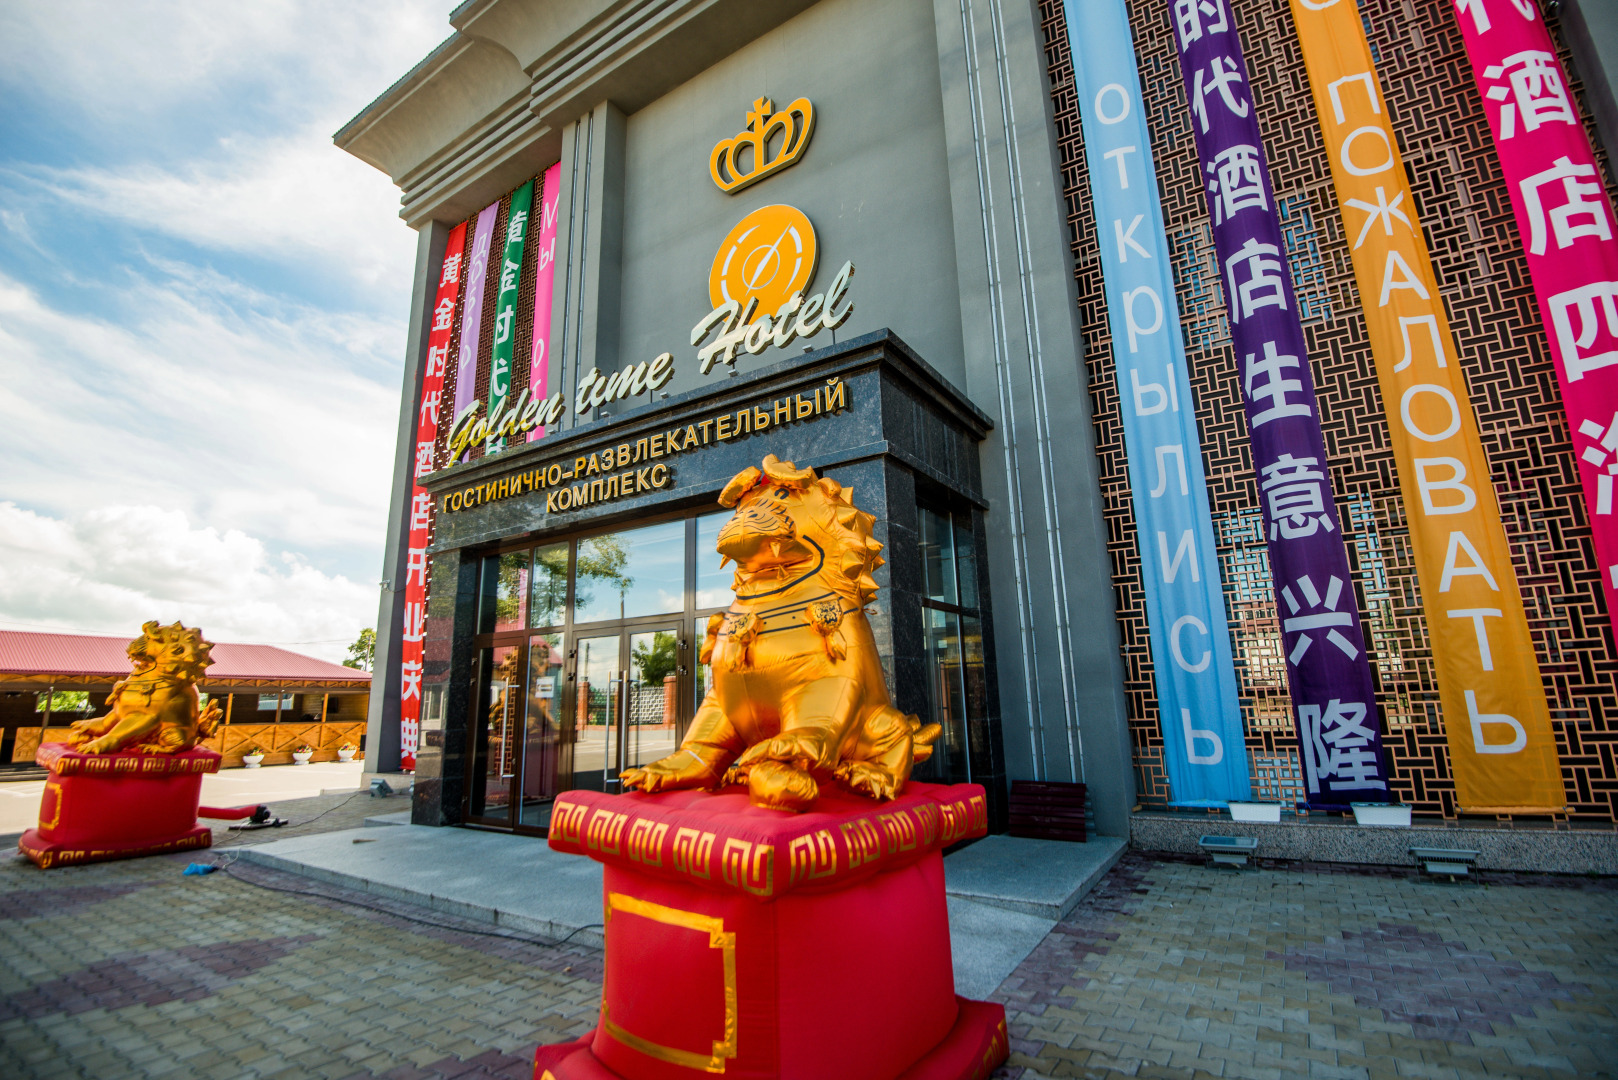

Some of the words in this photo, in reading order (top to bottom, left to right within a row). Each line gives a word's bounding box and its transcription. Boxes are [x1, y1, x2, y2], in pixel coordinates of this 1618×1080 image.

[443, 376, 847, 514] ГОСТИНИЧНО-РАЗВЛЕКАТЕЛЬНЫЙ
[446, 387, 566, 468] Golden
[690, 259, 856, 375] Hotel
[1327, 71, 1528, 754] ПОЖАЛОВАТЬ
[546, 463, 669, 514] КОМПЛЕКС
